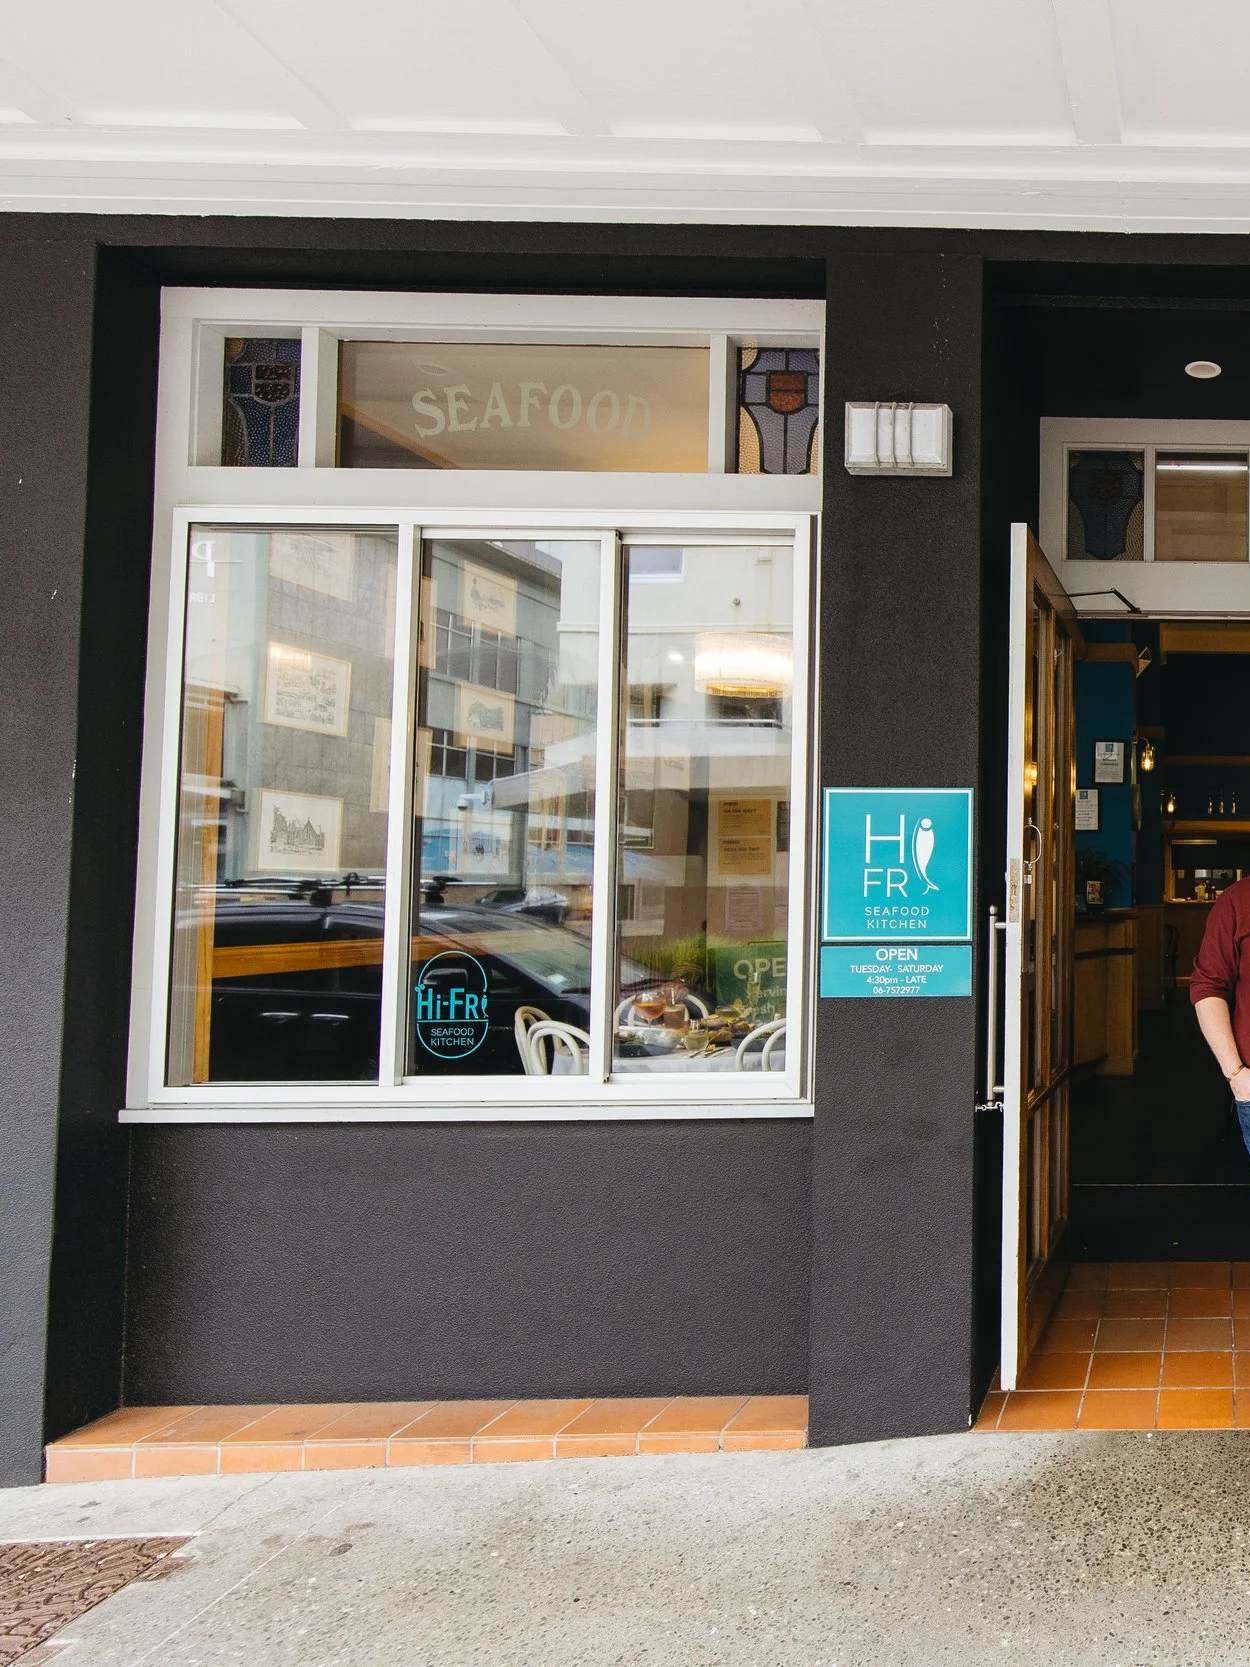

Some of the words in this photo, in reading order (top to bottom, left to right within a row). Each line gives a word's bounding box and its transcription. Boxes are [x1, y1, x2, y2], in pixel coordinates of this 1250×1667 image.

[411, 381, 653, 440] SEAFOOD
[864, 906, 930, 916] SEAFOOD
[867, 919, 928, 929] KITCHEN
[876, 948, 918, 961] OPEN
[897, 964, 944, 973] SATURDAY
[866, 976, 898, 985] 4:30pm
[906, 976, 927, 984] LATE
[872, 986, 920, 995] 06-7572977
[430, 1027, 475, 1036] SEAFOOD
[430, 1037, 475, 1046] KITCHEN
